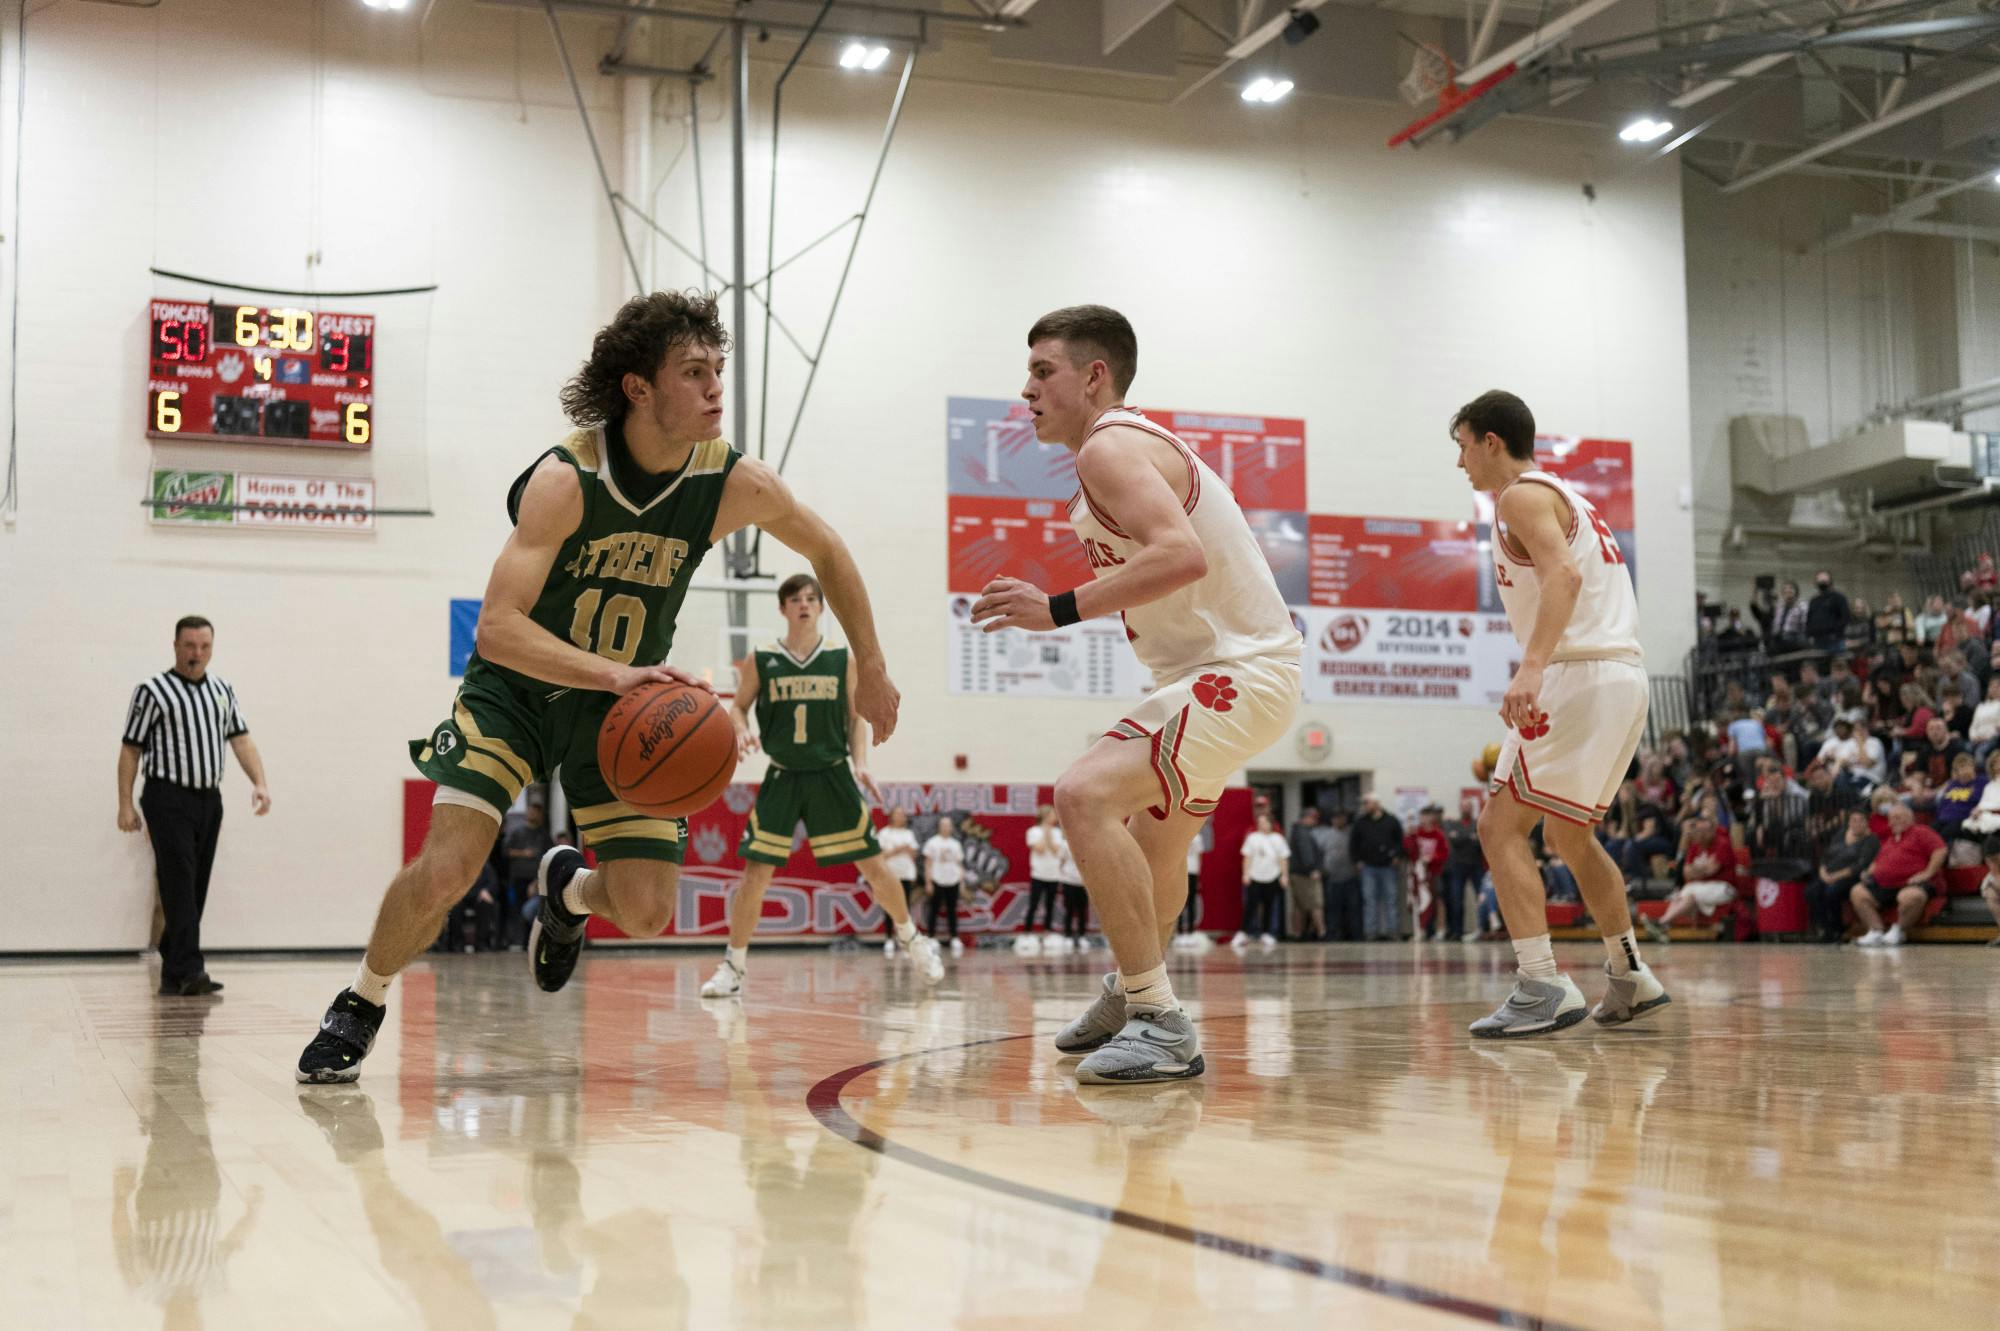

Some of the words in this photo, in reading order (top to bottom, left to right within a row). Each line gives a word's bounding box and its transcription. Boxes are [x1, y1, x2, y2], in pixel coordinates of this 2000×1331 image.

[152, 303, 209, 324] TOMCATS
[319, 315, 372, 335] GUEST
[160, 319, 205, 361] 50
[253, 352, 272, 380] 4
[157, 391, 182, 432] 6
[346, 402, 370, 444] 6
[247, 480, 297, 496] Home
[305, 480, 326, 496] Of
[335, 481, 365, 497] The
[569, 588, 647, 666] 10
[1387, 615, 1451, 638] 2014
[1320, 660, 1387, 677] REGIONAL
[1391, 663, 1472, 680] CHAMPIONS
[769, 674, 839, 703] ATHENS
[1333, 680, 1376, 696] STATE
[1380, 682, 1419, 697] FINAL
[1423, 684, 1460, 699] FOUR
[638, 692, 698, 761] Rawlings
[793, 703, 808, 744] 1
